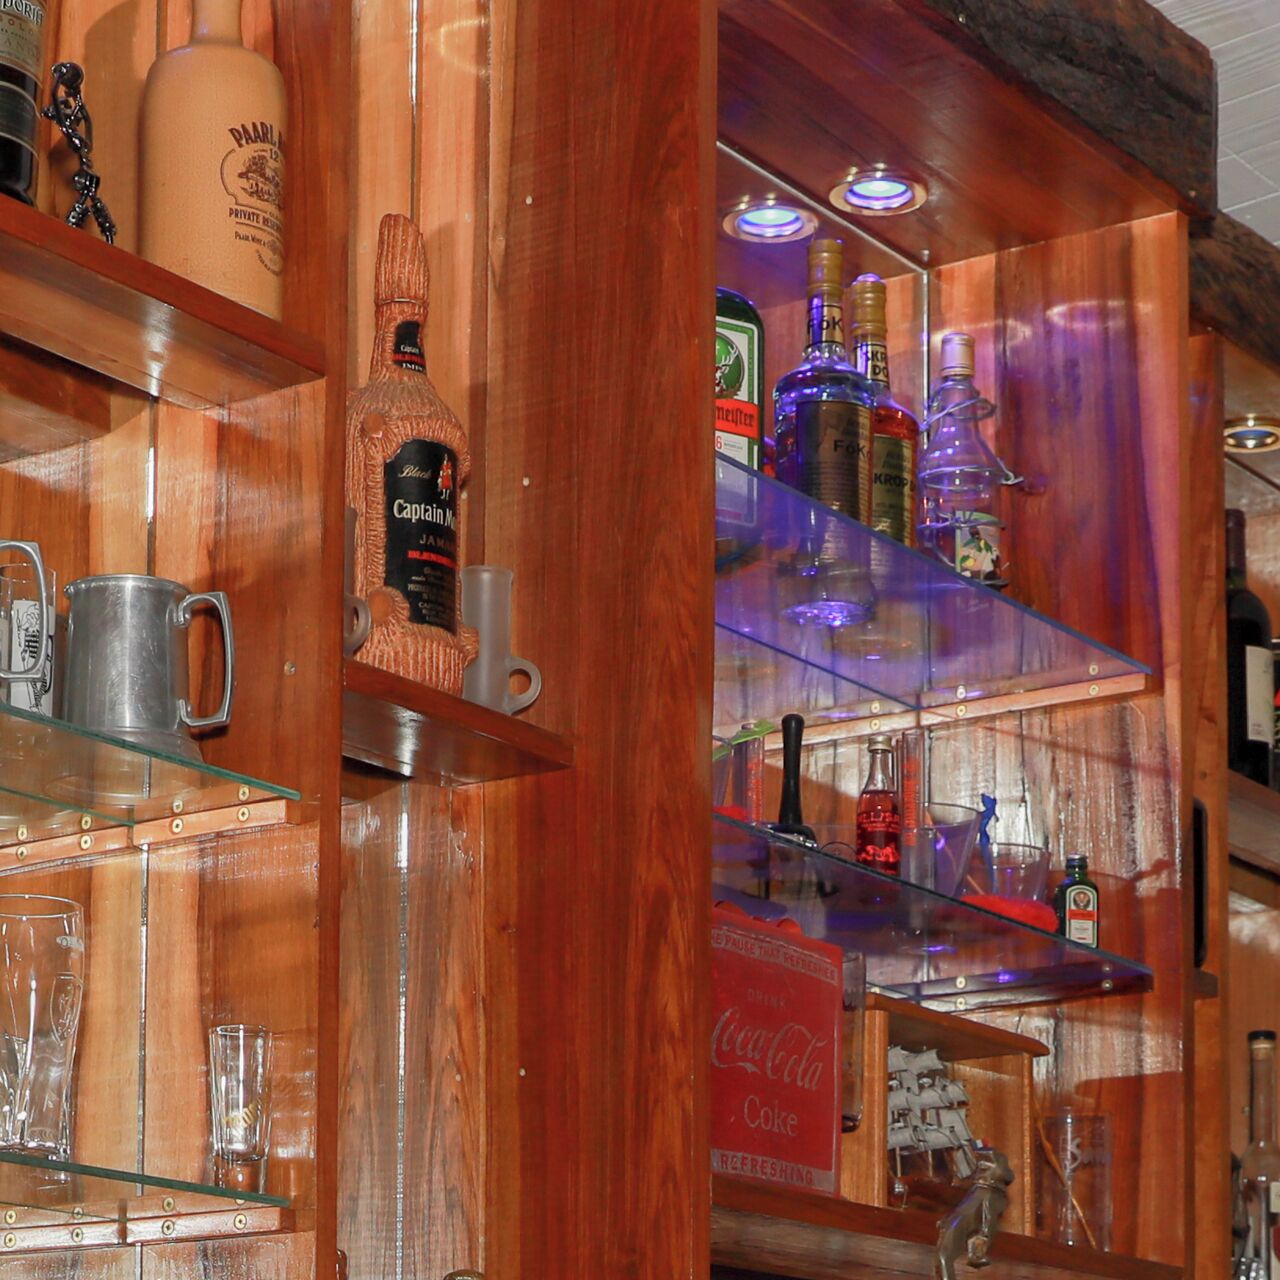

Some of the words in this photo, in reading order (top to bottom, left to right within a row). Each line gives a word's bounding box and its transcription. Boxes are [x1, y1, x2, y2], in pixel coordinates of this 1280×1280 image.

[228, 121, 277, 149] PAARL
[228, 207, 261, 224] PRIVATE
[397, 463, 432, 480] Black
[392, 498, 444, 526] Captain
[743, 1095, 799, 1137] Coke
[720, 1152, 814, 1186] REFRESHING
